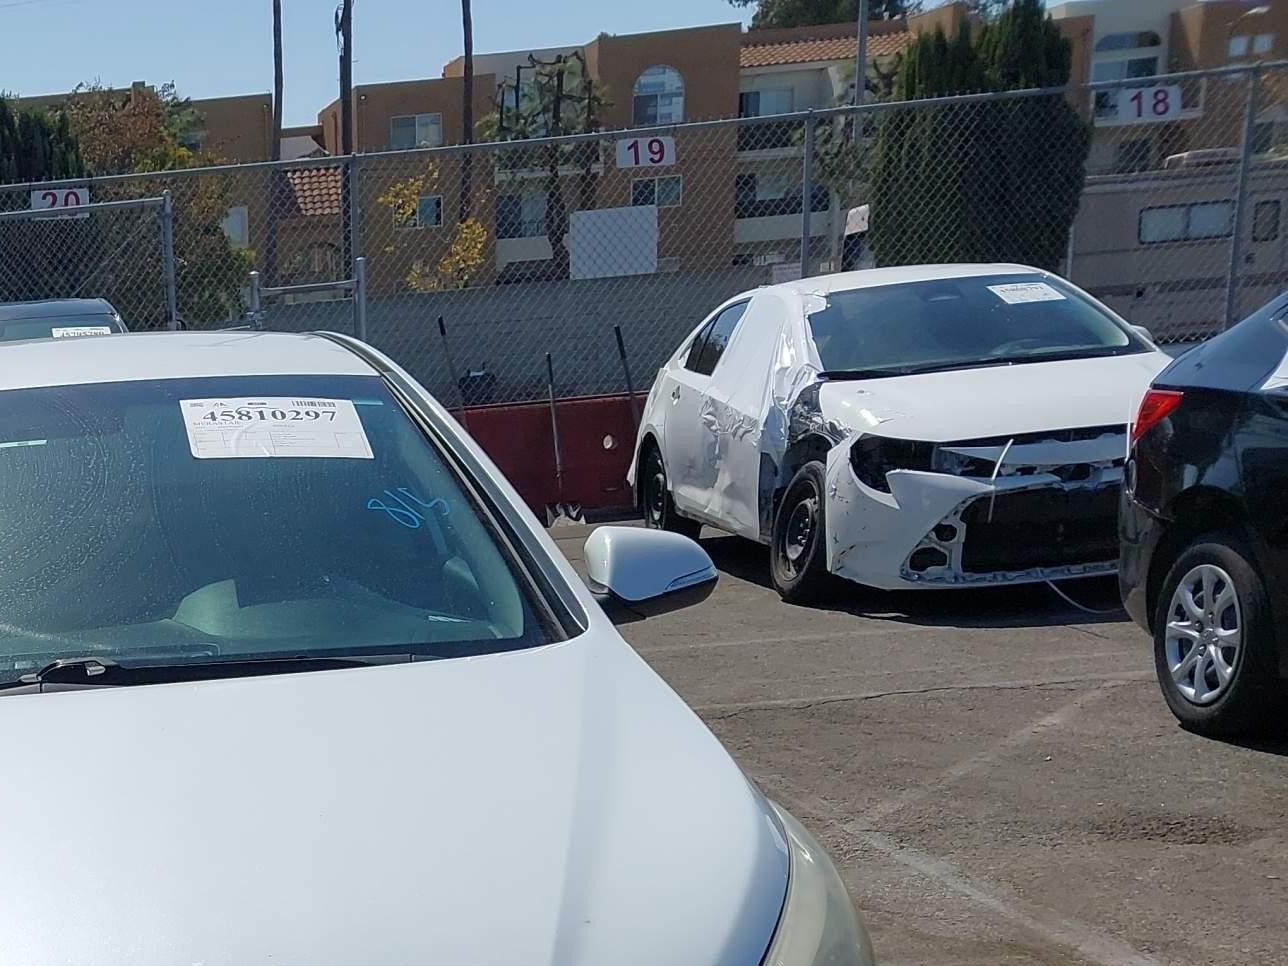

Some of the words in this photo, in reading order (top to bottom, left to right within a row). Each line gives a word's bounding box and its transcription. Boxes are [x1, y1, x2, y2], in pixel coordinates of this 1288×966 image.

[1130, 88, 1170, 118] 18
[626, 138, 665, 166] 19
[41, 190, 81, 217] 20
[202, 408, 337, 423] 45810297
